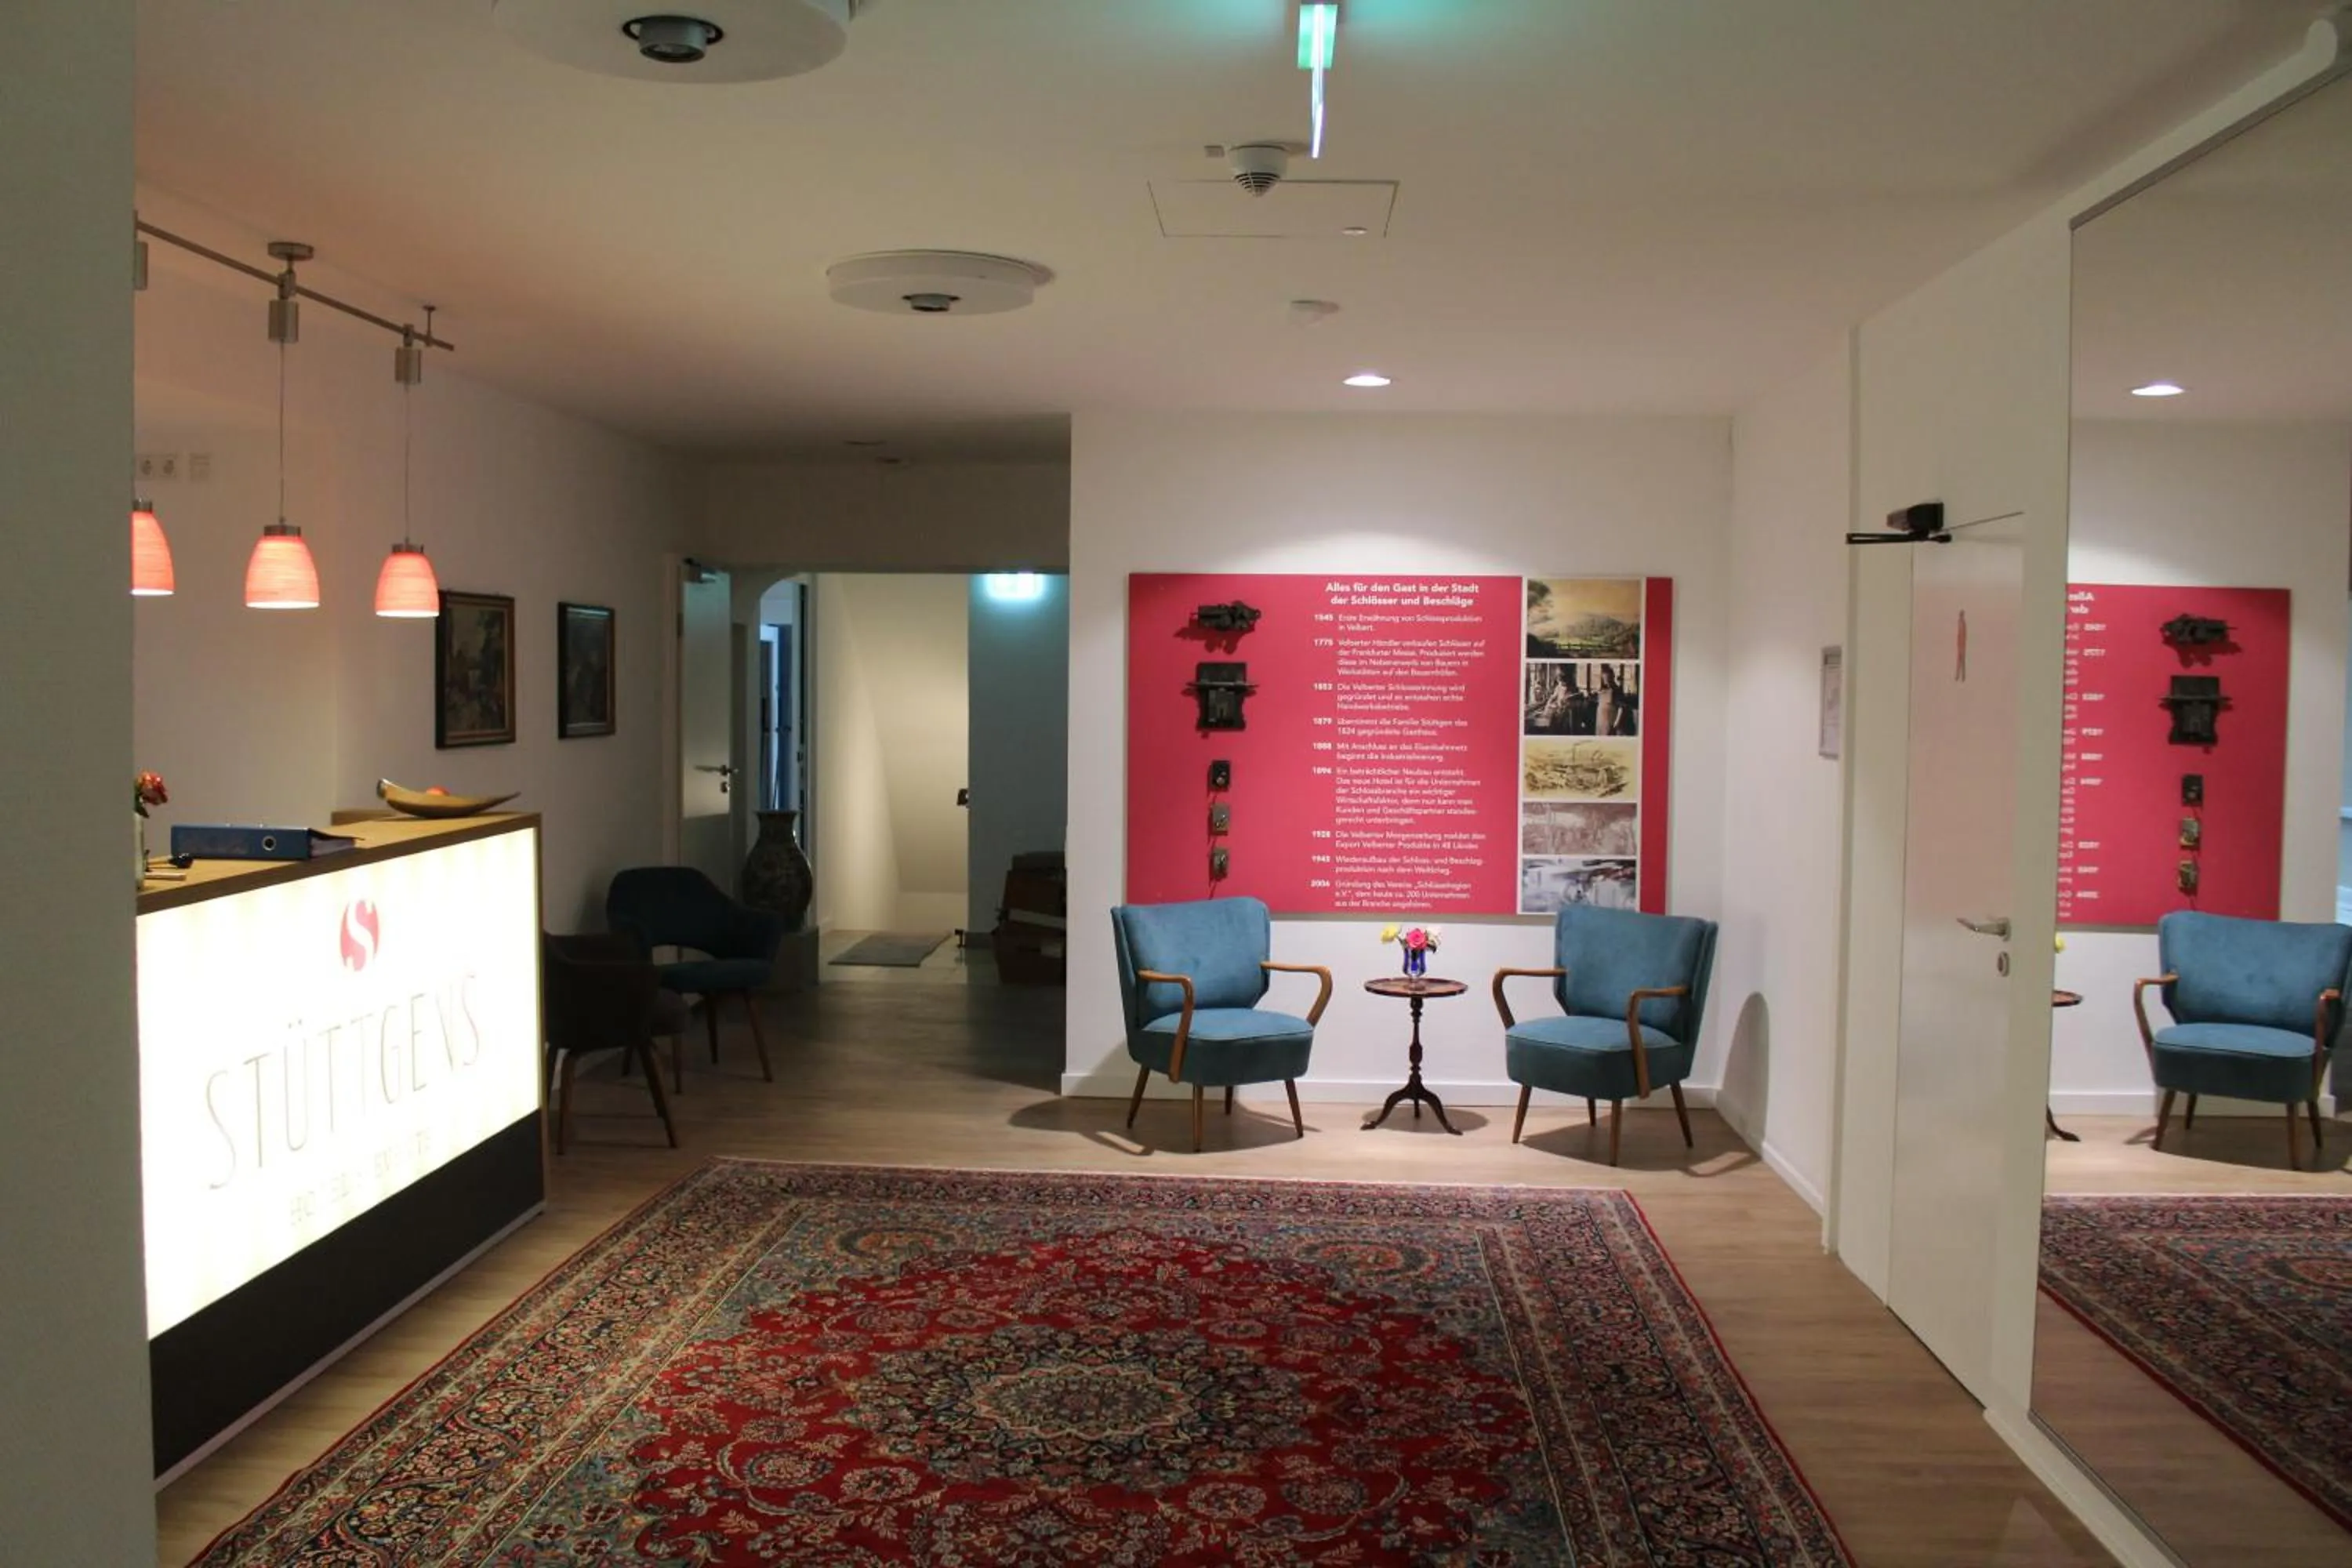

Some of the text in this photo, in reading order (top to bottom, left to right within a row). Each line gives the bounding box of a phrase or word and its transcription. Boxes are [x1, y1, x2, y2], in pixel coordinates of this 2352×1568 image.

[1325, 581, 1351, 592] Alles
[1353, 582, 1367, 593] für
[1370, 582, 1390, 593] den
[1392, 582, 1417, 593] Gast
[1431, 583, 1449, 593] der
[1451, 583, 1479, 593] Stadt
[1330, 595, 1474, 608] der Schlösser und Beschläge
